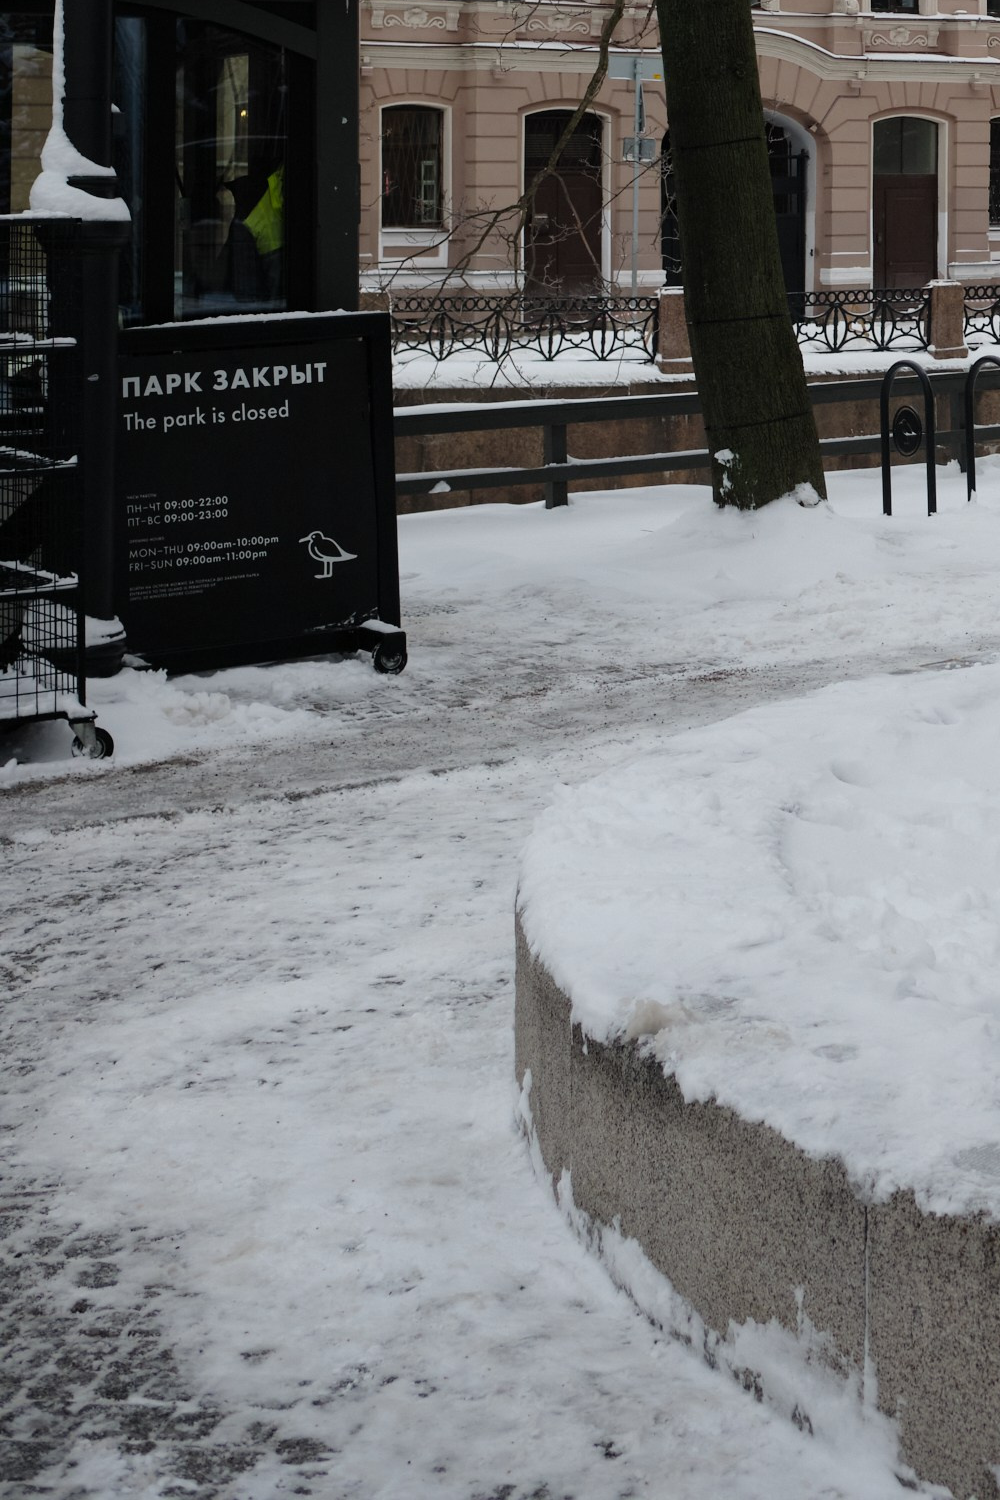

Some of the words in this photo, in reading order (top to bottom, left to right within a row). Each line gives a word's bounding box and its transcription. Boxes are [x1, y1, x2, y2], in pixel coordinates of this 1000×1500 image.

[122, 371, 203, 398] ПАРК
[212, 362, 327, 391] ЗАКРЫТ
[123, 412, 157, 431] The
[163, 406, 206, 433] park
[212, 407, 226, 424] is
[231, 399, 290, 422] closed
[164, 495, 229, 511] 09:00-22:00
[164, 508, 229, 524] 09:00-23:00
[187, 535, 279, 553] 09:00am-10:00pm
[176, 549, 267, 567] 09:00am-11:00pm
